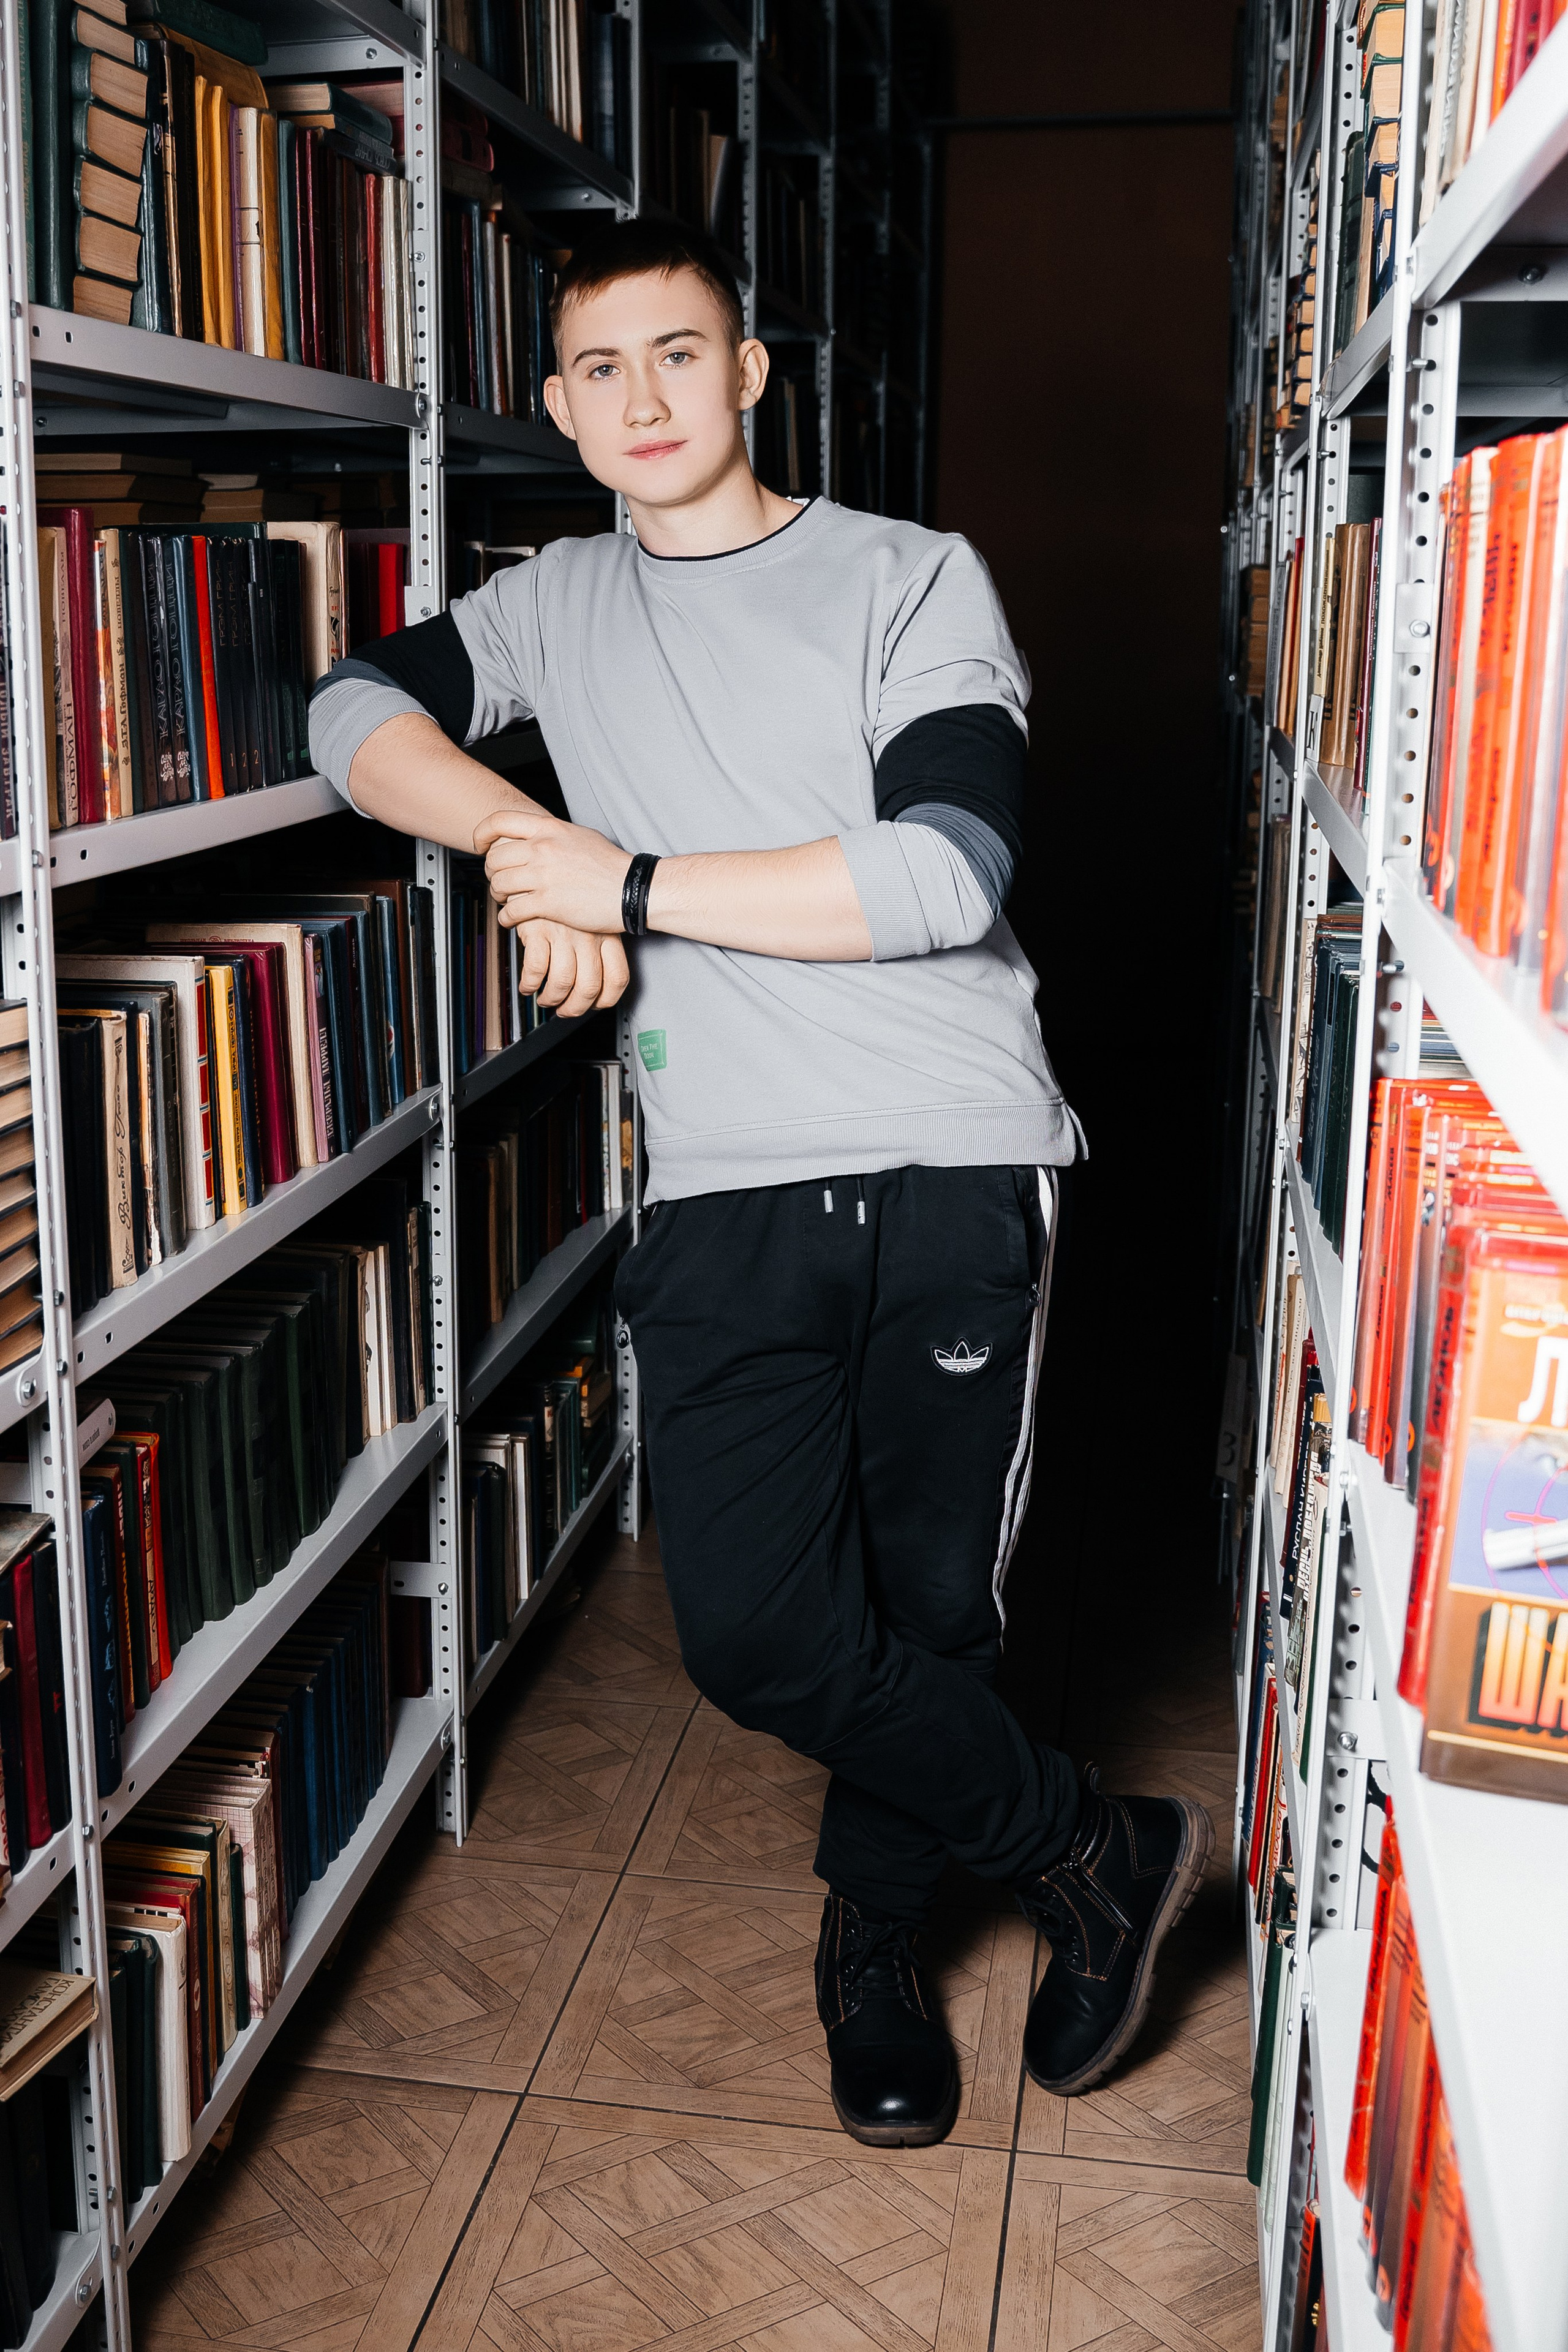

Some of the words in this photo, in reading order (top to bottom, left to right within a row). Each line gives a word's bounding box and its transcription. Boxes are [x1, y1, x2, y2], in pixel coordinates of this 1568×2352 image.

[66, 702, 78, 812] ГОФМАН
[115, 1085, 126, 1139] Гюго
[117, 1147, 130, 1230] Виктор
[1292, 1501, 1303, 1561] РУСЛАН
[0, 1979, 75, 2051] КОНСТАНТИ
